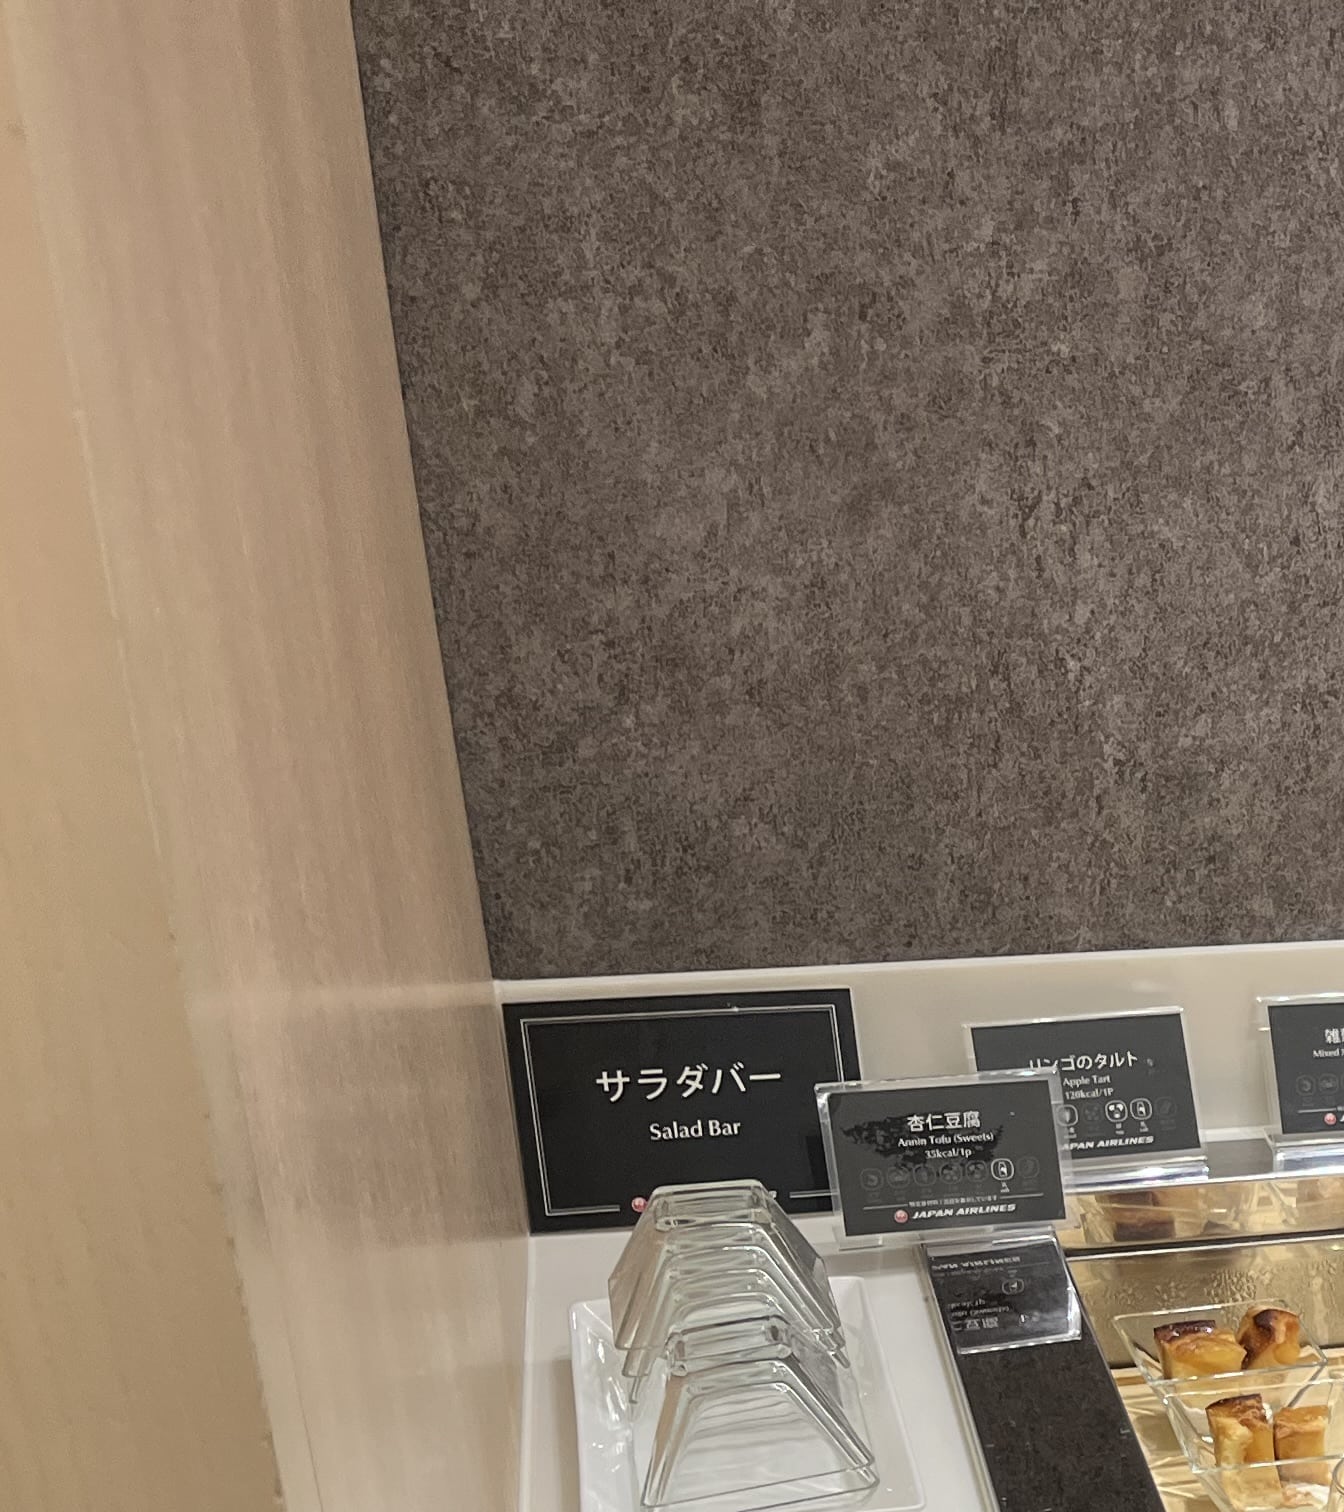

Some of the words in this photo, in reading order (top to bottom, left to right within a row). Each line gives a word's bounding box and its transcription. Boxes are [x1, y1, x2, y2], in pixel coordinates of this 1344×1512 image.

[1313, 1048, 1340, 1058] Mixed
[596, 1062, 781, 1102] サラダバー
[1063, 1075, 1090, 1088] Apple
[1091, 1074, 1111, 1084] Tart
[907, 1110, 981, 1132] 杏仁豆腐
[650, 1119, 703, 1141] Salad
[708, 1119, 741, 1137] Bar
[898, 1135, 927, 1148] Annin
[929, 1135, 952, 1146] Tofu
[953, 1131, 995, 1145] (Sweets)
[1060, 1141, 1095, 1151] APAN
[1097, 1136, 1154, 1149] AIRLINES
[912, 1208, 953, 1220] JAPAN
[956, 1203, 1016, 1216] AIRLINES
